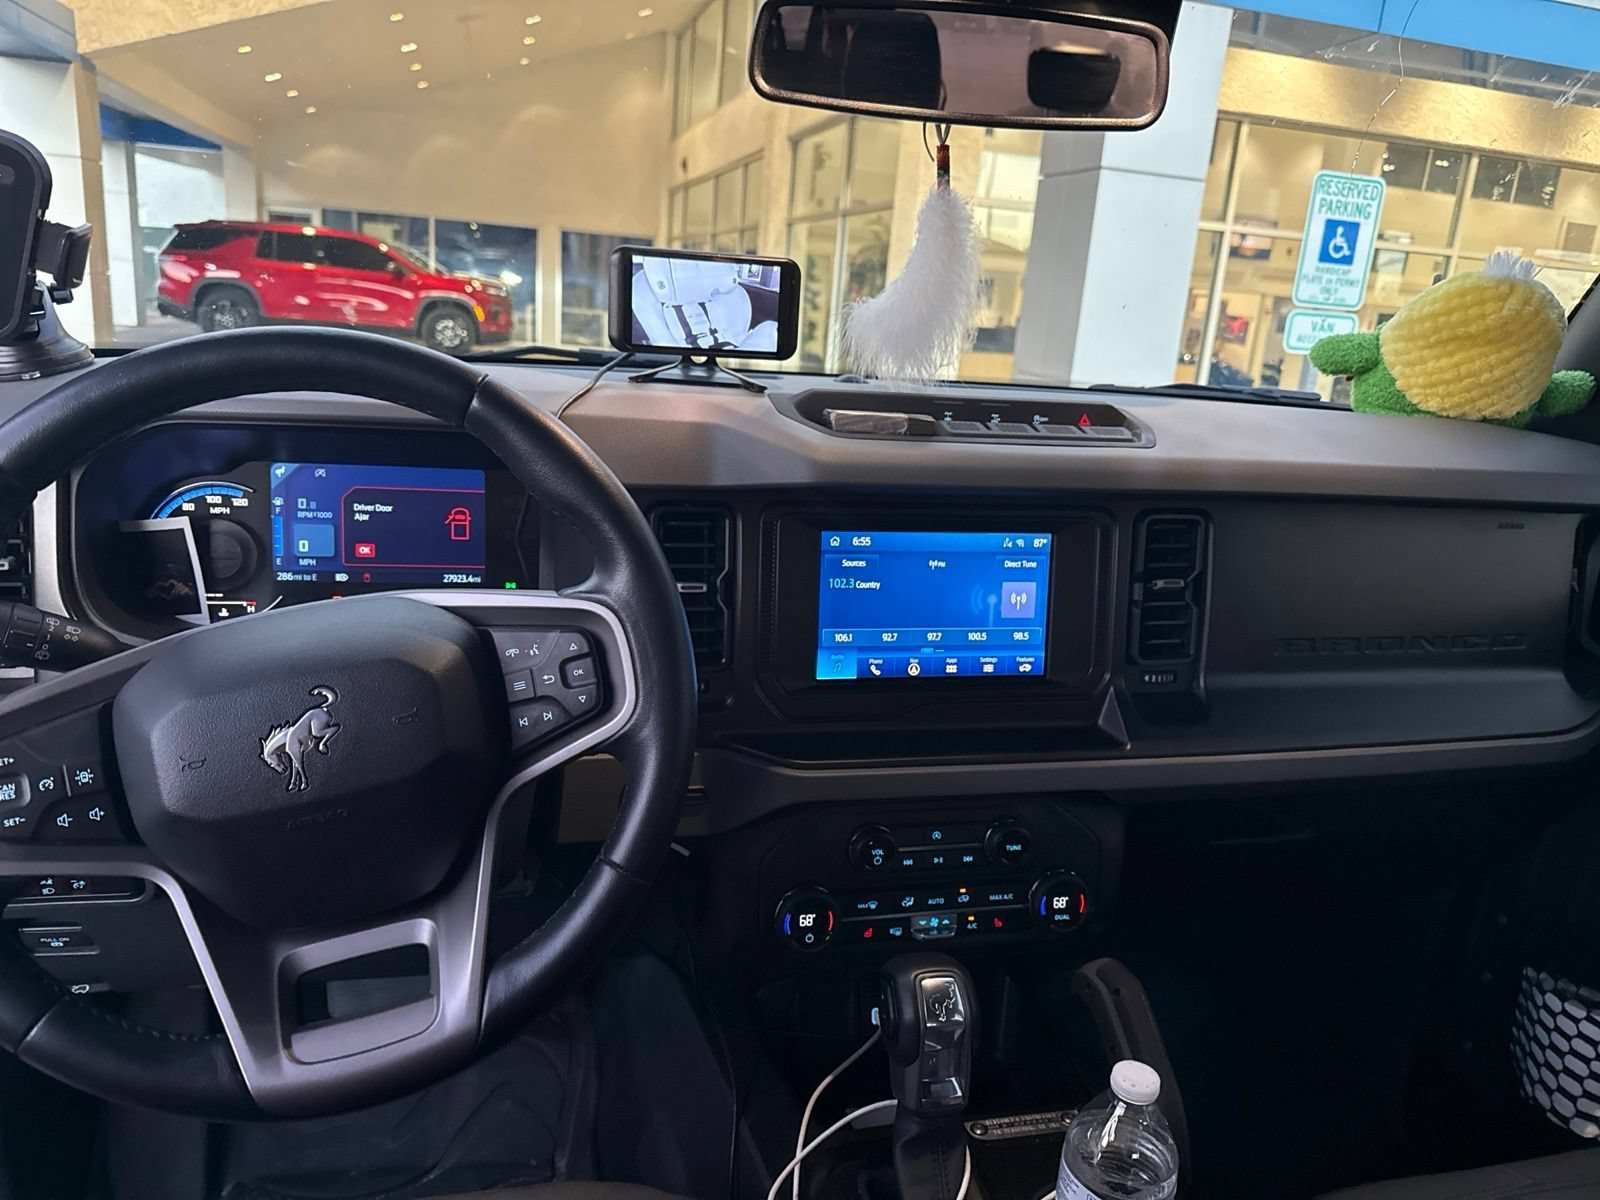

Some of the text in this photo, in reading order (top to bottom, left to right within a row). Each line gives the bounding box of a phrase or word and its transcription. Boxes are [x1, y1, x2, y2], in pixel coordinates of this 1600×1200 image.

[1317, 179, 1379, 201] RESERVED
[1318, 198, 1373, 220] PARKING
[1311, 320, 1335, 333] VAN
[205, 495, 222, 504] 100
[231, 498, 249, 507] 120
[182, 502, 195, 511] 80
[353, 503, 393, 512] Driver Door
[354, 513, 370, 521] Ajar
[852, 537, 872, 546] 6:55
[299, 558, 316, 566] MPH
[841, 559, 867, 567] Sources
[1004, 560, 1021, 568] Direct
[828, 578, 854, 589] 102.3
[855, 580, 881, 590] Country
[834, 633, 853, 642] 106.1
[882, 633, 898, 641] 92.7
[927, 632, 942, 641] 97.7
[968, 632, 987, 641] 100.5
[1013, 632, 1029, 640] 98.5
[1274, 633, 1527, 656] BRONCO
[979, 656, 998, 664] Settings
[0, 757, 15, 767] ET+
[871, 848, 884, 856] VOL
[927, 897, 945, 905] AUTO
[989, 892, 1014, 901] MAX A/C
[1054, 913, 1070, 921] DUAL
[966, 921, 978, 930] A/C
